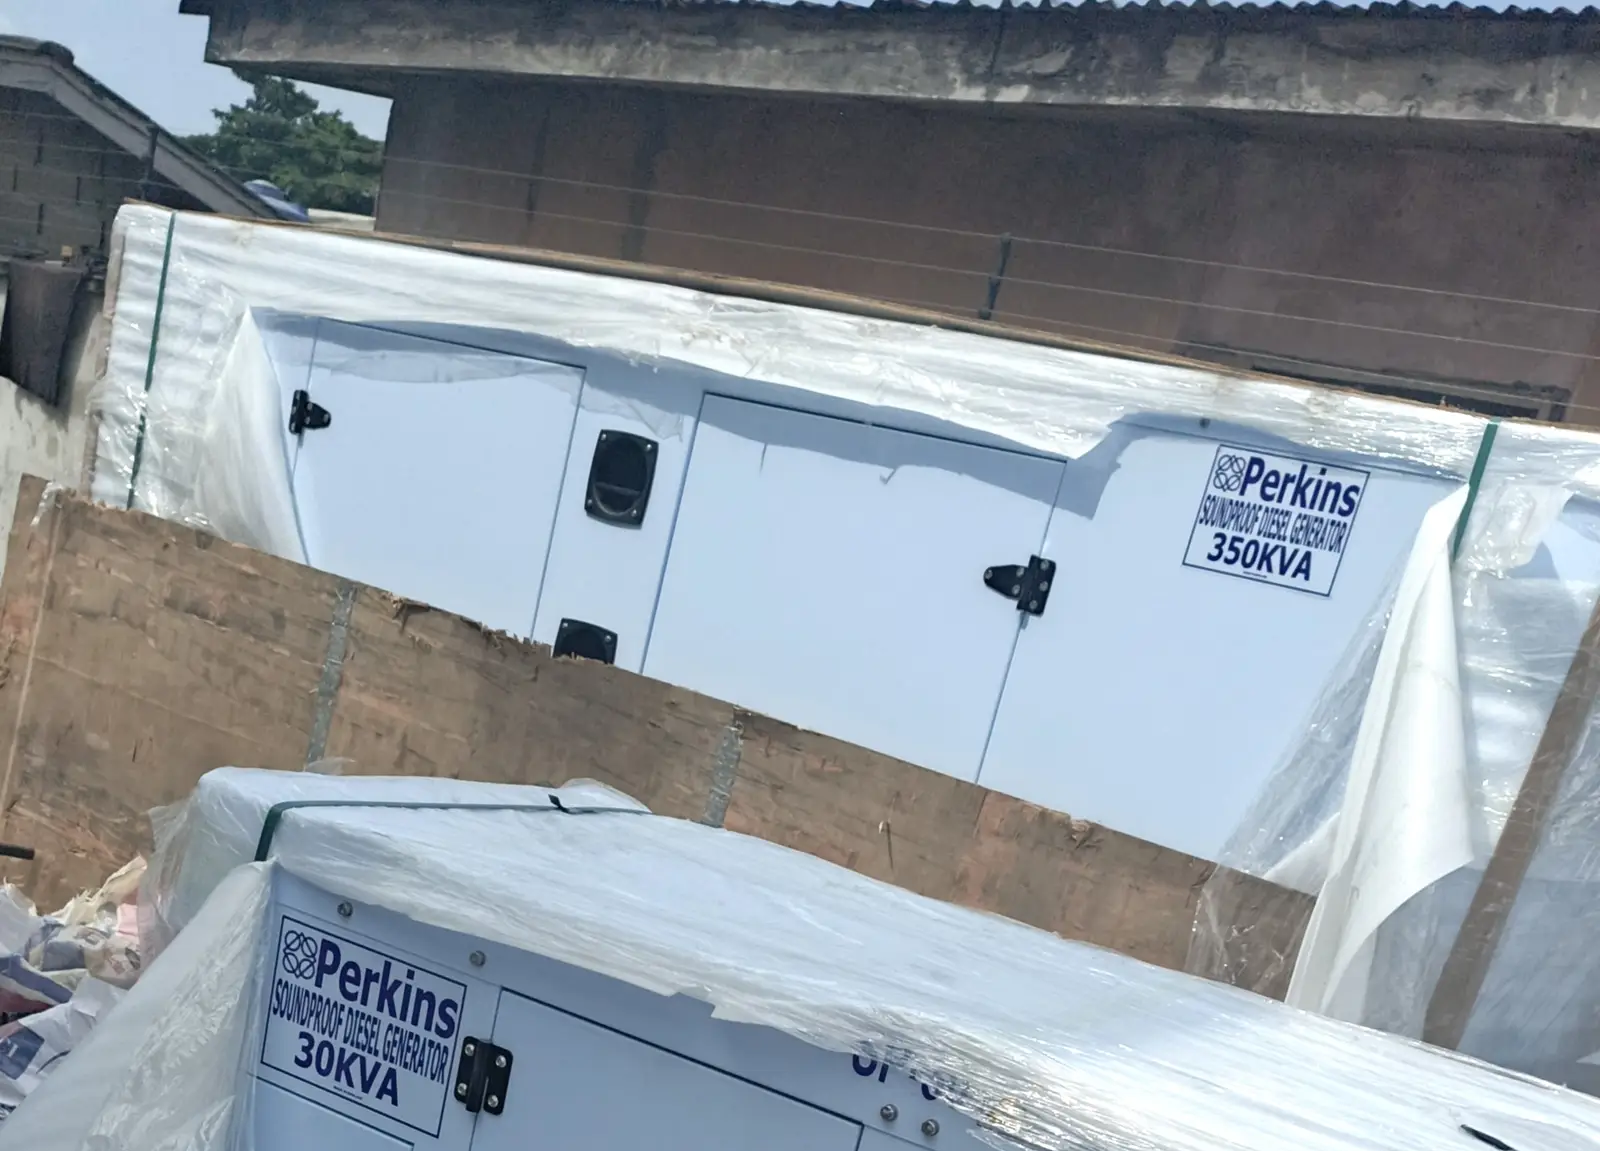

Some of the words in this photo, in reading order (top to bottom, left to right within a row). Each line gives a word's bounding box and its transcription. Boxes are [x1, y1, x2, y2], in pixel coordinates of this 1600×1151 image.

[1239, 456, 1361, 517] Perkins
[1199, 494, 1263, 535] SOUNDPROOF
[1257, 506, 1293, 542] DIESEL
[1290, 512, 1347, 553] GENERATOR
[1206, 532, 1313, 581] 350KVA
[314, 938, 459, 1039] Perkins
[272, 978, 346, 1043] SOUNDPROOF
[342, 1006, 382, 1057] DIESEL
[382, 1023, 449, 1085] GENERATOR
[294, 1031, 399, 1107] 30KVA
